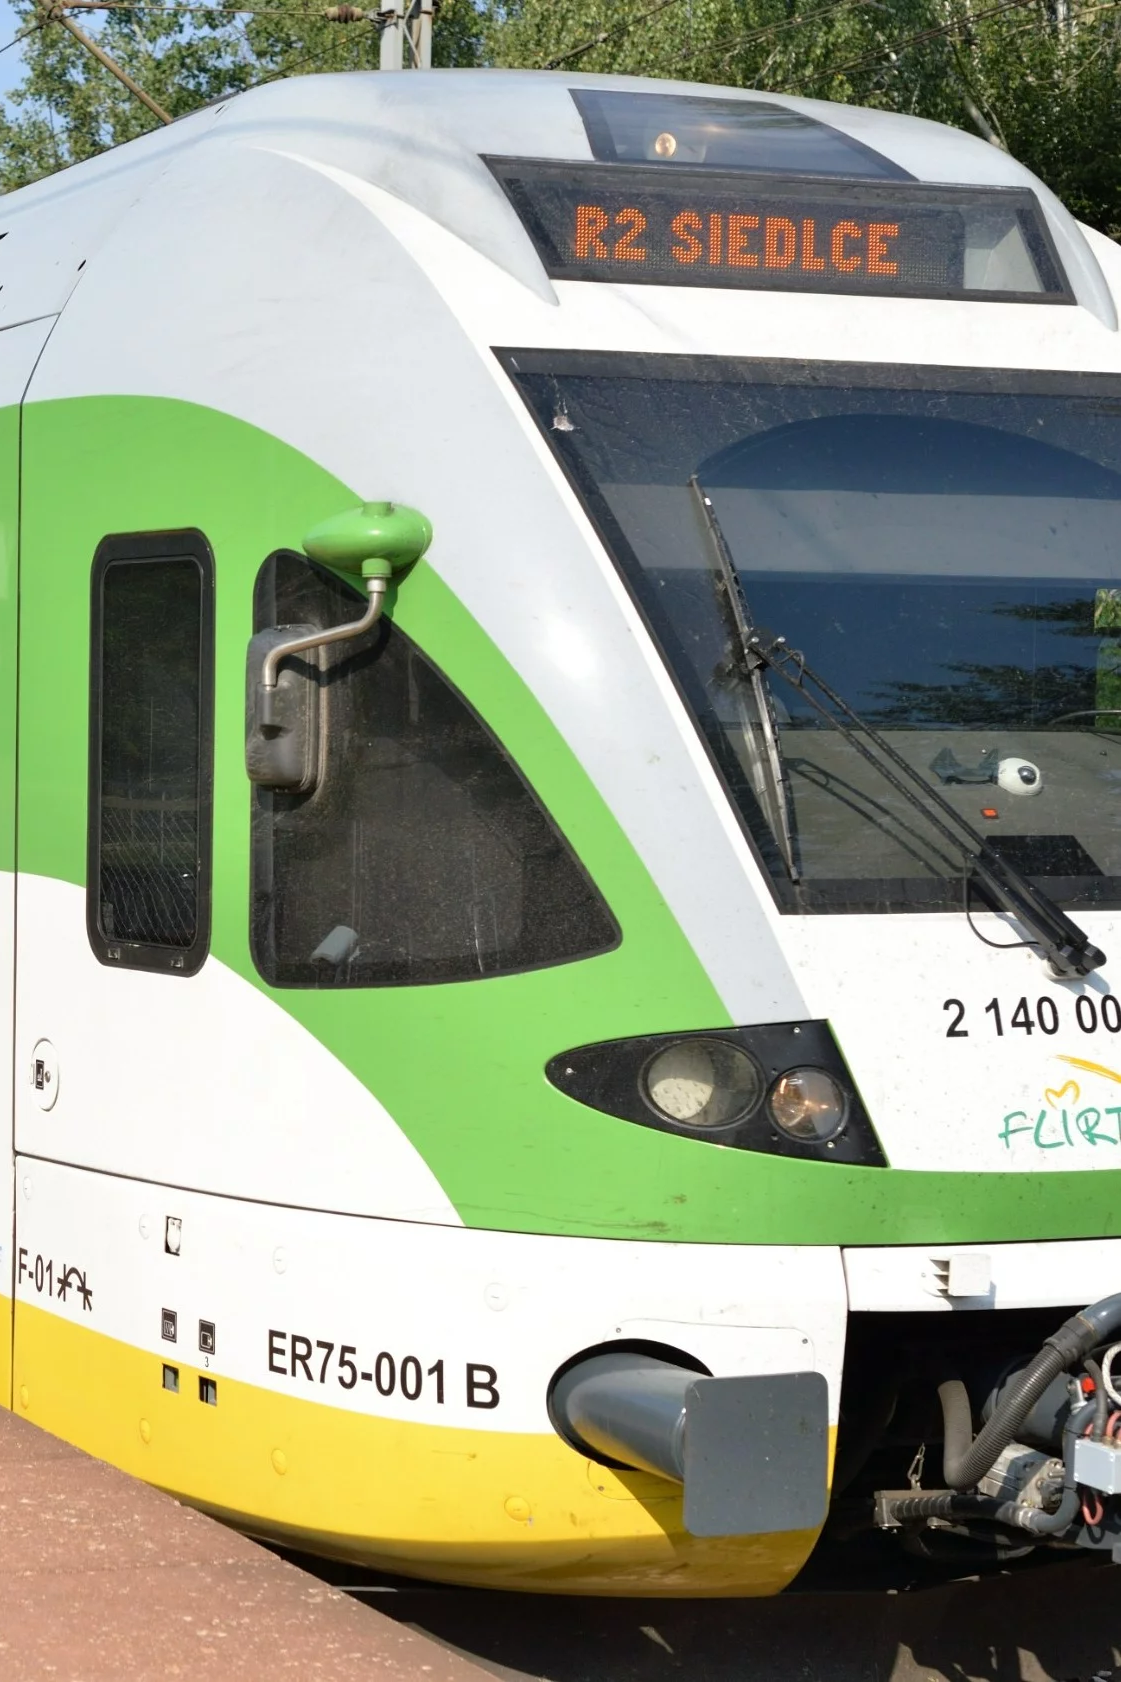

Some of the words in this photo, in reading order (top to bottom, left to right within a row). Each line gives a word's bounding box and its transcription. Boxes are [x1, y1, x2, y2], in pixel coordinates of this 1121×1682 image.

[574, 204, 647, 262] R2
[670, 209, 899, 276] SIEDLCE
[943, 998, 969, 1038] 2
[985, 996, 1060, 1037] 140
[18, 1247, 54, 1297] F-01
[204, 1356, 210, 1368] 3
[267, 1328, 447, 1406] ER75-001
[465, 1362, 501, 1410] B
